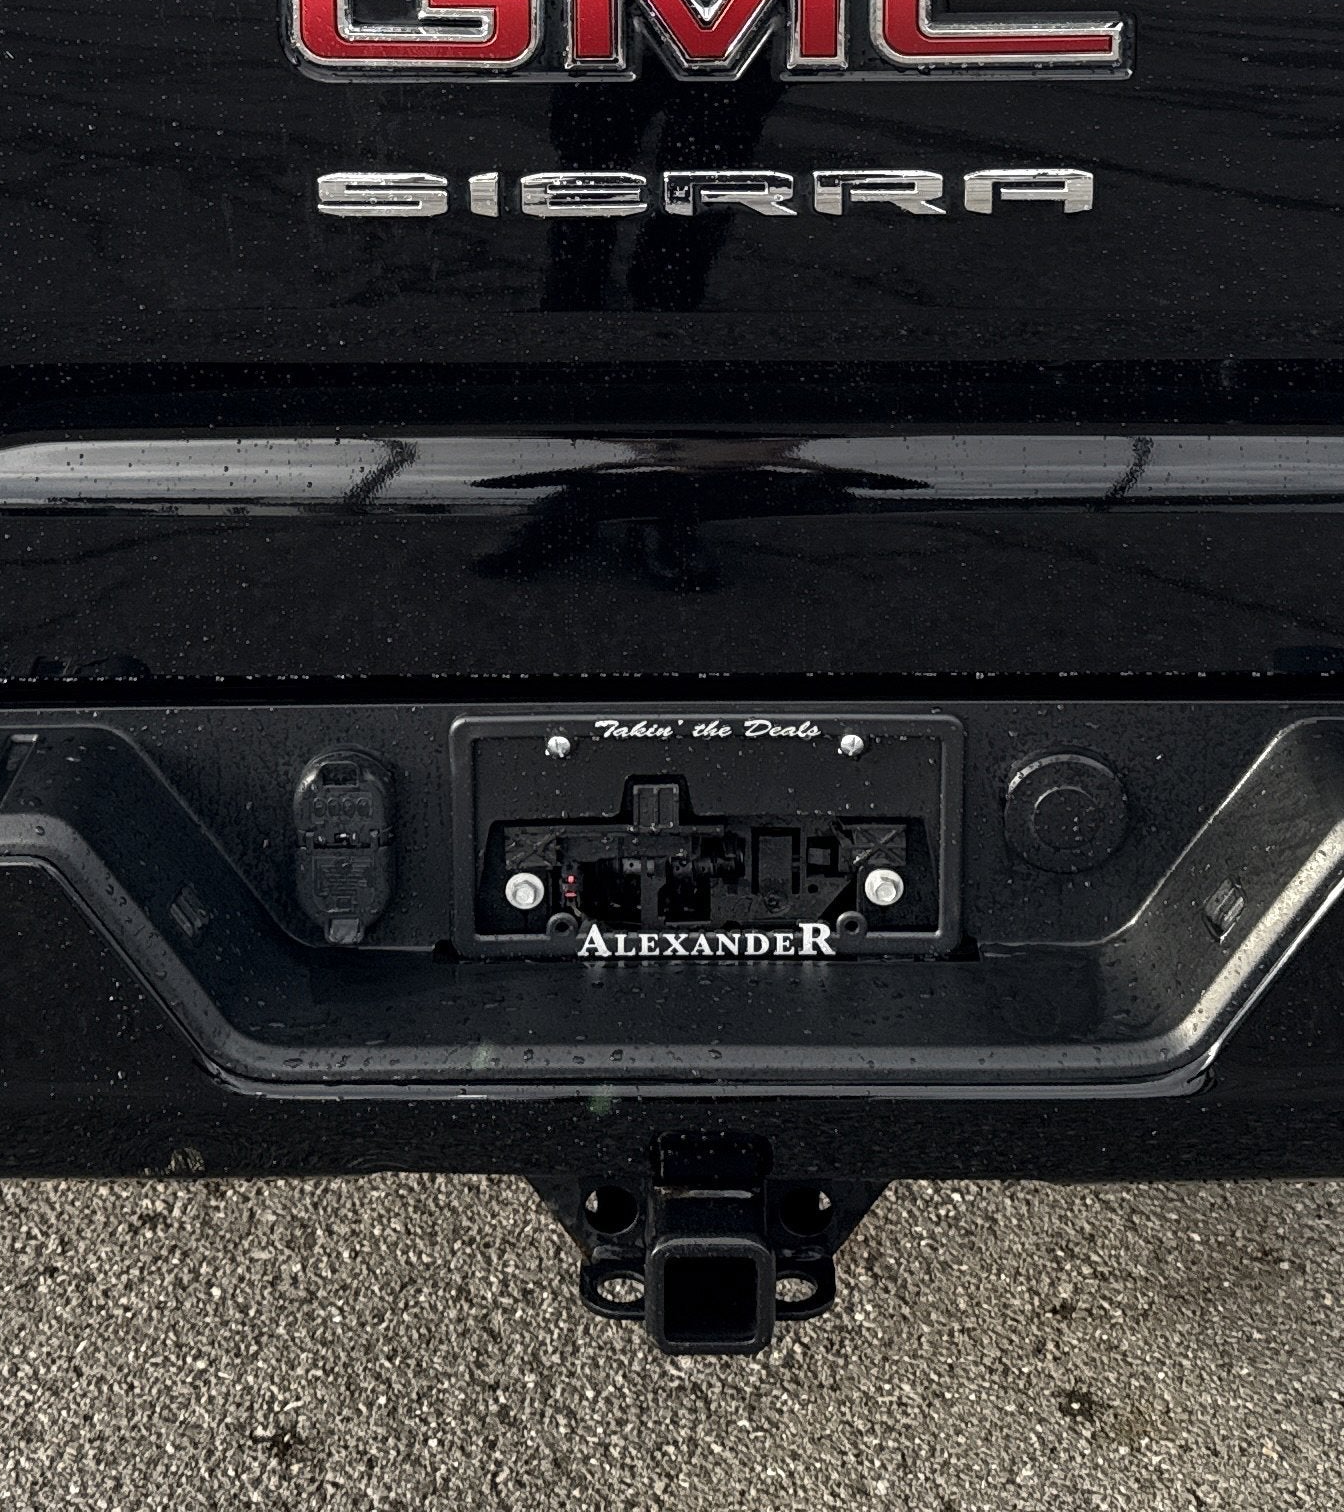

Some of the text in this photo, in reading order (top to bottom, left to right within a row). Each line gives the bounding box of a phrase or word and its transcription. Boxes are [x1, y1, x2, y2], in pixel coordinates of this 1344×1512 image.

[317, 169, 1096, 218] SIERRA
[594, 719, 822, 738] Takin' the Deals
[577, 922, 836, 957] ALEXANDER
